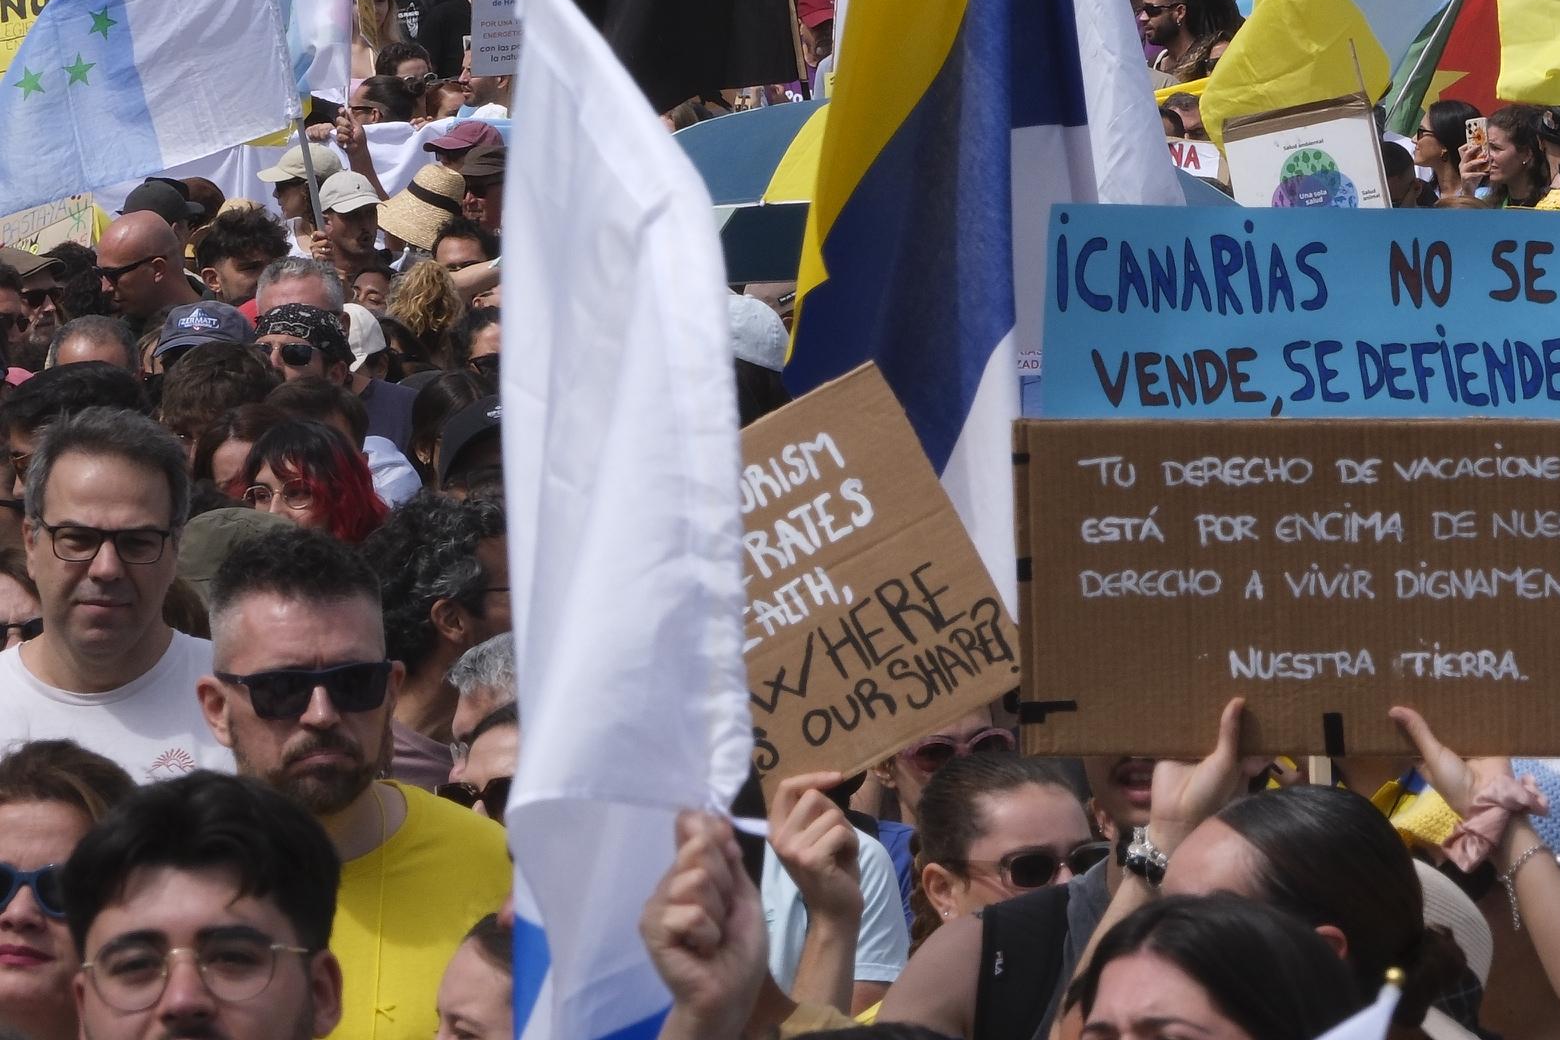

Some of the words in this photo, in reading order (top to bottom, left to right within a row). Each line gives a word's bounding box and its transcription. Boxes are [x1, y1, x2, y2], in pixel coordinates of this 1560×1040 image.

[480, 44, 496, 53] con
[497, 43, 509, 52] las
[490, 53, 499, 63] la
[1305, 197, 1324, 206] salud
[1389, 237, 1453, 310] NO
[1489, 239, 1558, 304] SE
[1078, 457, 1137, 488] TU
[1161, 456, 1314, 487] DERECHO
[1335, 458, 1383, 485] DE
[1081, 505, 1165, 544] ESTÁ
[1194, 513, 1260, 548] POR
[1275, 502, 1404, 544] ENCIMA
[1432, 511, 1478, 541] DE
[1079, 568, 1222, 598] DERECHO
[1244, 570, 1265, 600] A
[802, 677, 898, 747] OUR
[886, 596, 1021, 710] SHARE?
[1229, 645, 1377, 680] NUESTRA
